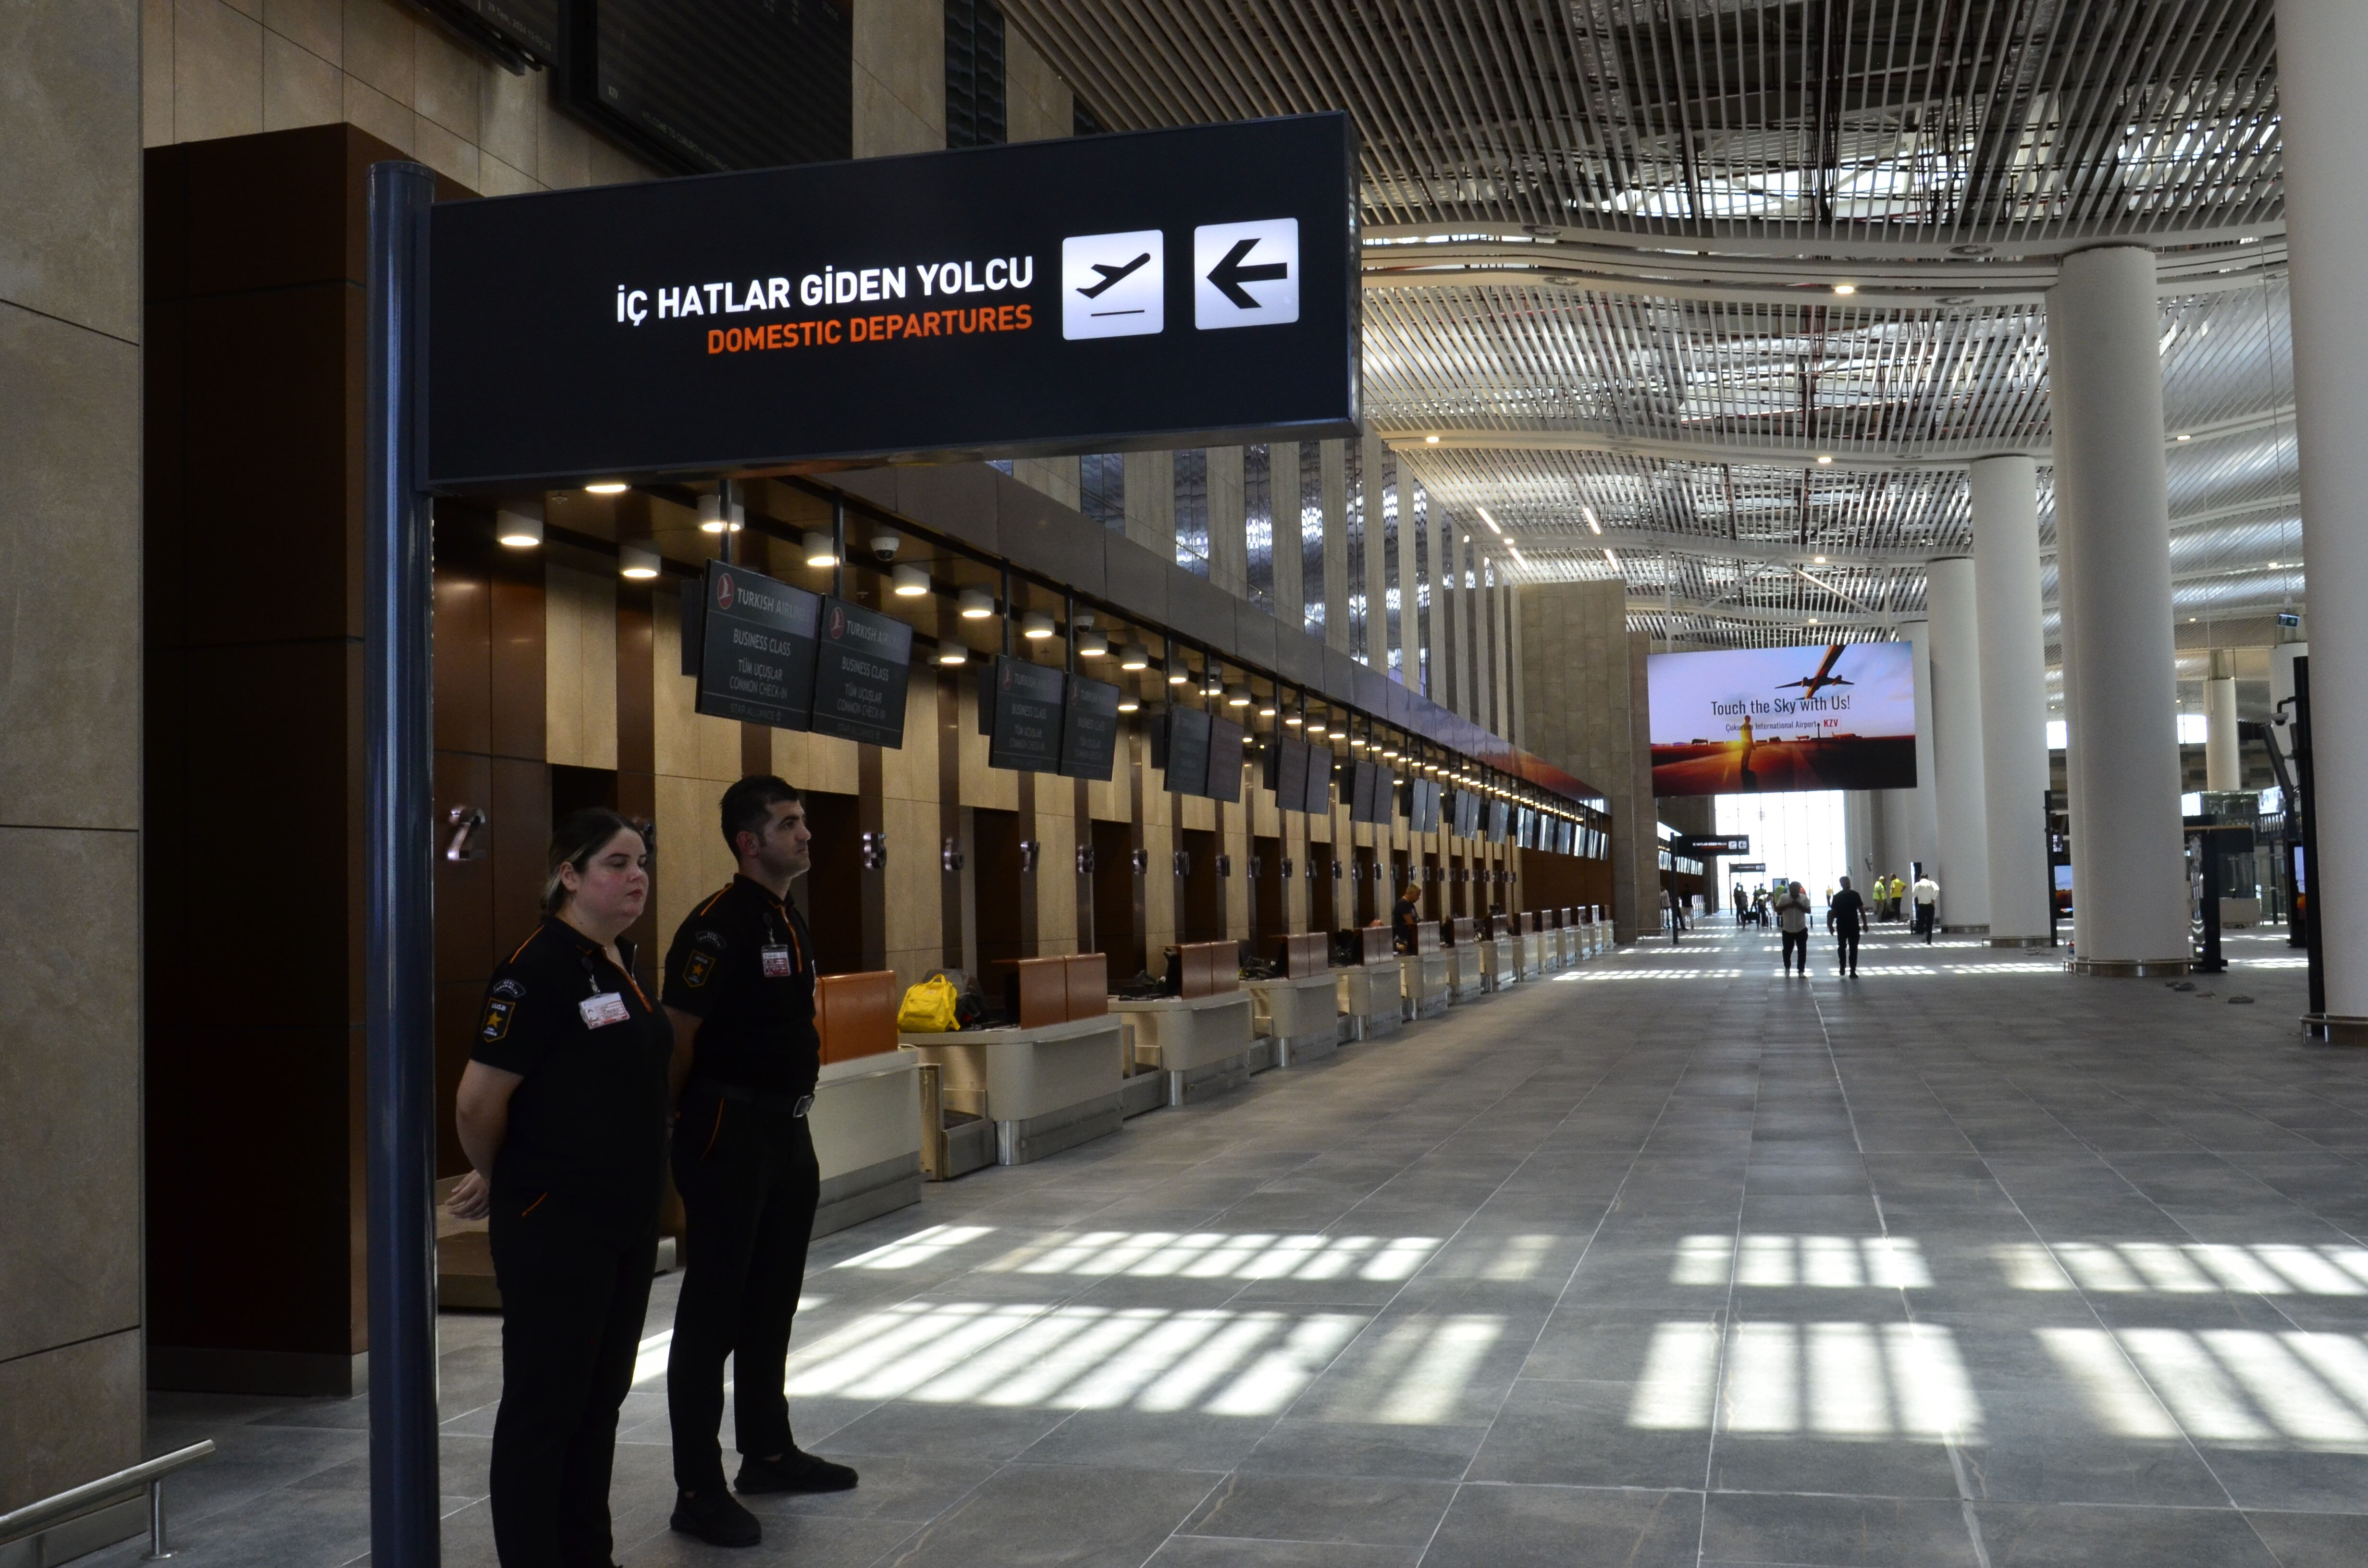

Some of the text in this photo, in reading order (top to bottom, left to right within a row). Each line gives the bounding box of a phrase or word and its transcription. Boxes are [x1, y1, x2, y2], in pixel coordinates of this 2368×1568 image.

[617, 255, 1033, 326] İÇ HATLAR GİDEN YOLCU
[707, 304, 1033, 355] DOMESTIC DEPARTURES
[738, 587, 807, 622] TURKISH AIRLIN
[733, 628, 791, 657] BUSINESS CLASS
[846, 620, 876, 642] TURKISH
[738, 657, 752, 674] TÜM
[842, 656, 888, 681] BUSINESS CLASS
[729, 675, 788, 699] COMMON CHECK-IN
[1711, 695, 1850, 715] Touch the Sky with Us!
[1755, 723, 1794, 731] International
[1795, 721, 1817, 729] Airport
[1824, 719, 1838, 728] KZV
